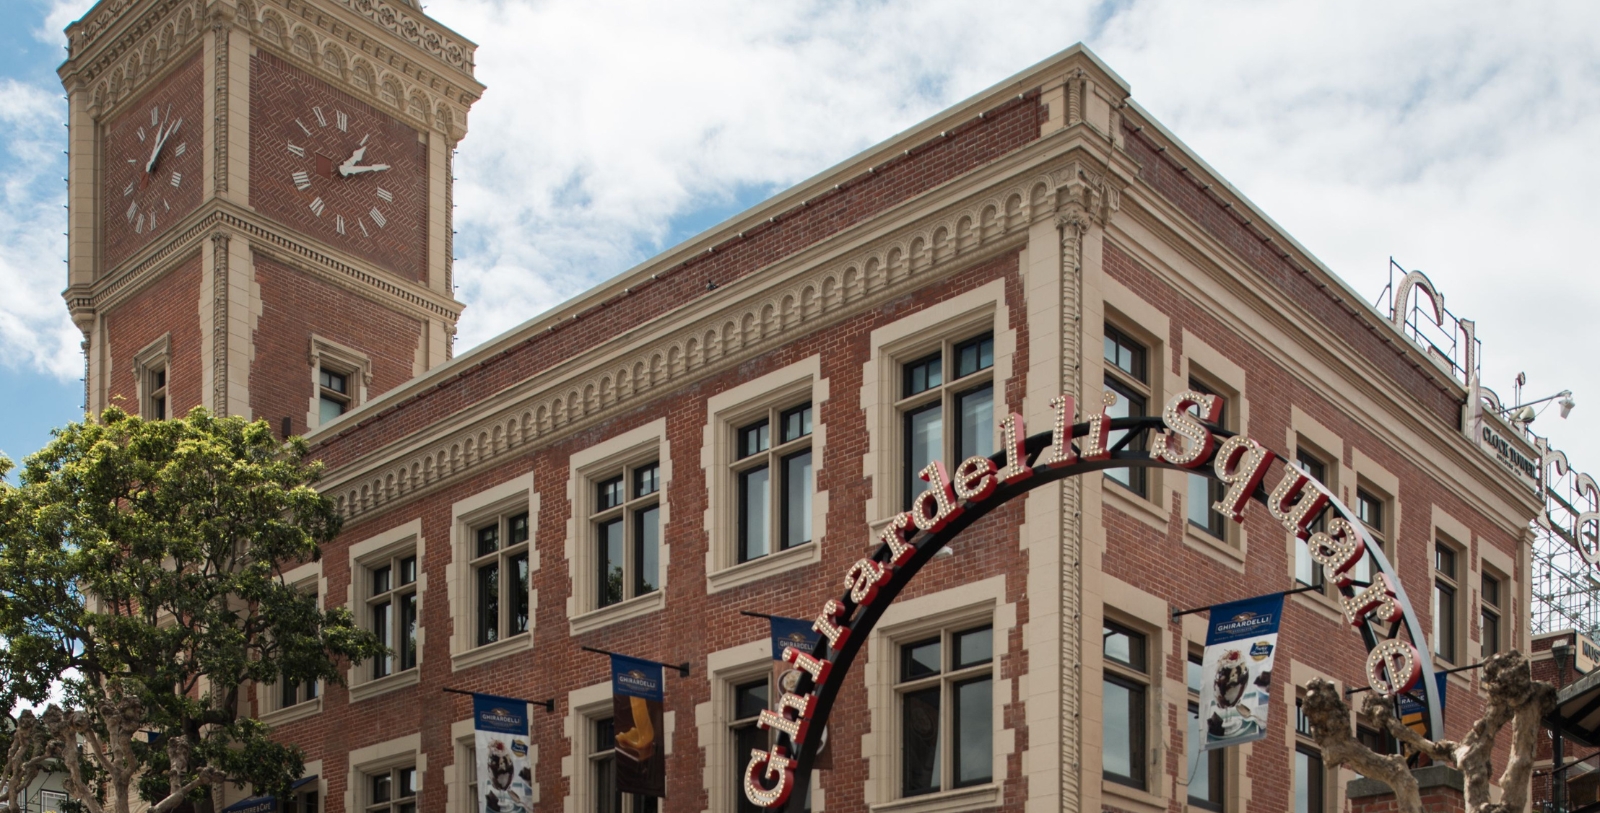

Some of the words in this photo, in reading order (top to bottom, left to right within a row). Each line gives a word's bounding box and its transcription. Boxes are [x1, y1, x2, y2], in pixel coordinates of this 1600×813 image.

[1482, 426, 1509, 459] CLOCK
[1509, 446, 1537, 479] TOWER
[744, 390, 1118, 808] Ghirardelli
[1149, 389, 1421, 695] Square
[1217, 616, 1269, 632] GHIRARDELLI
[780, 640, 814, 650] GHIRARDELL
[619, 675, 656, 688] GHIRARDELLI
[482, 713, 520, 724] GHIRARDELLI
